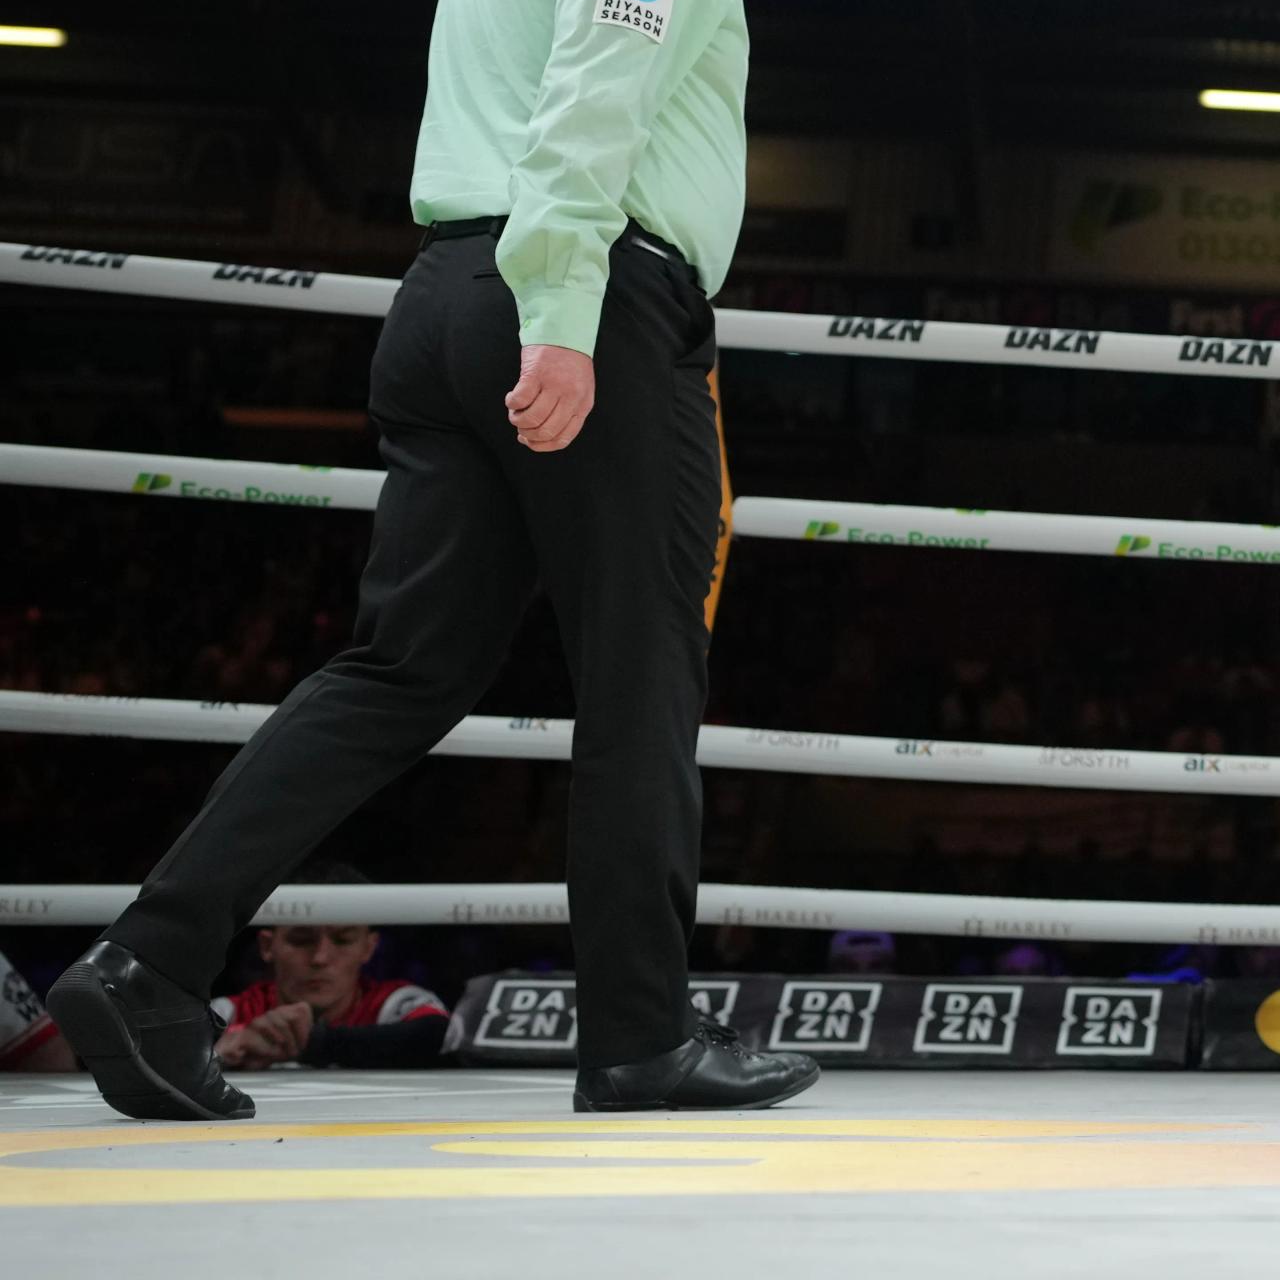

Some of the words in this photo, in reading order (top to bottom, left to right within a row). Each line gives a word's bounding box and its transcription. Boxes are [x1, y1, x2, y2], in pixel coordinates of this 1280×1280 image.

[601, 10, 662, 37] SEASON
[828, 316, 928, 343] DAZN
[1004, 326, 1101, 355] DAZN
[1179, 338, 1273, 367] DAZN
[180, 480, 333, 508] Eco-Power
[846, 527, 991, 550] Eco-Power
[1183, 754, 1221, 774] aix
[0, 898, 54, 916] RLEY
[260, 901, 316, 918] RLEY
[755, 909, 834, 926] HARLEY
[994, 920, 1073, 937] HARLEY
[511, 989, 566, 1012] DA
[801, 990, 856, 1014] DA
[944, 993, 998, 1018] DA
[1085, 996, 1138, 1020] DA
[502, 1013, 560, 1037] ZN
[794, 1014, 850, 1039] ZN
[938, 1017, 994, 1042] ZN
[1080, 1021, 1135, 1046] ZN
